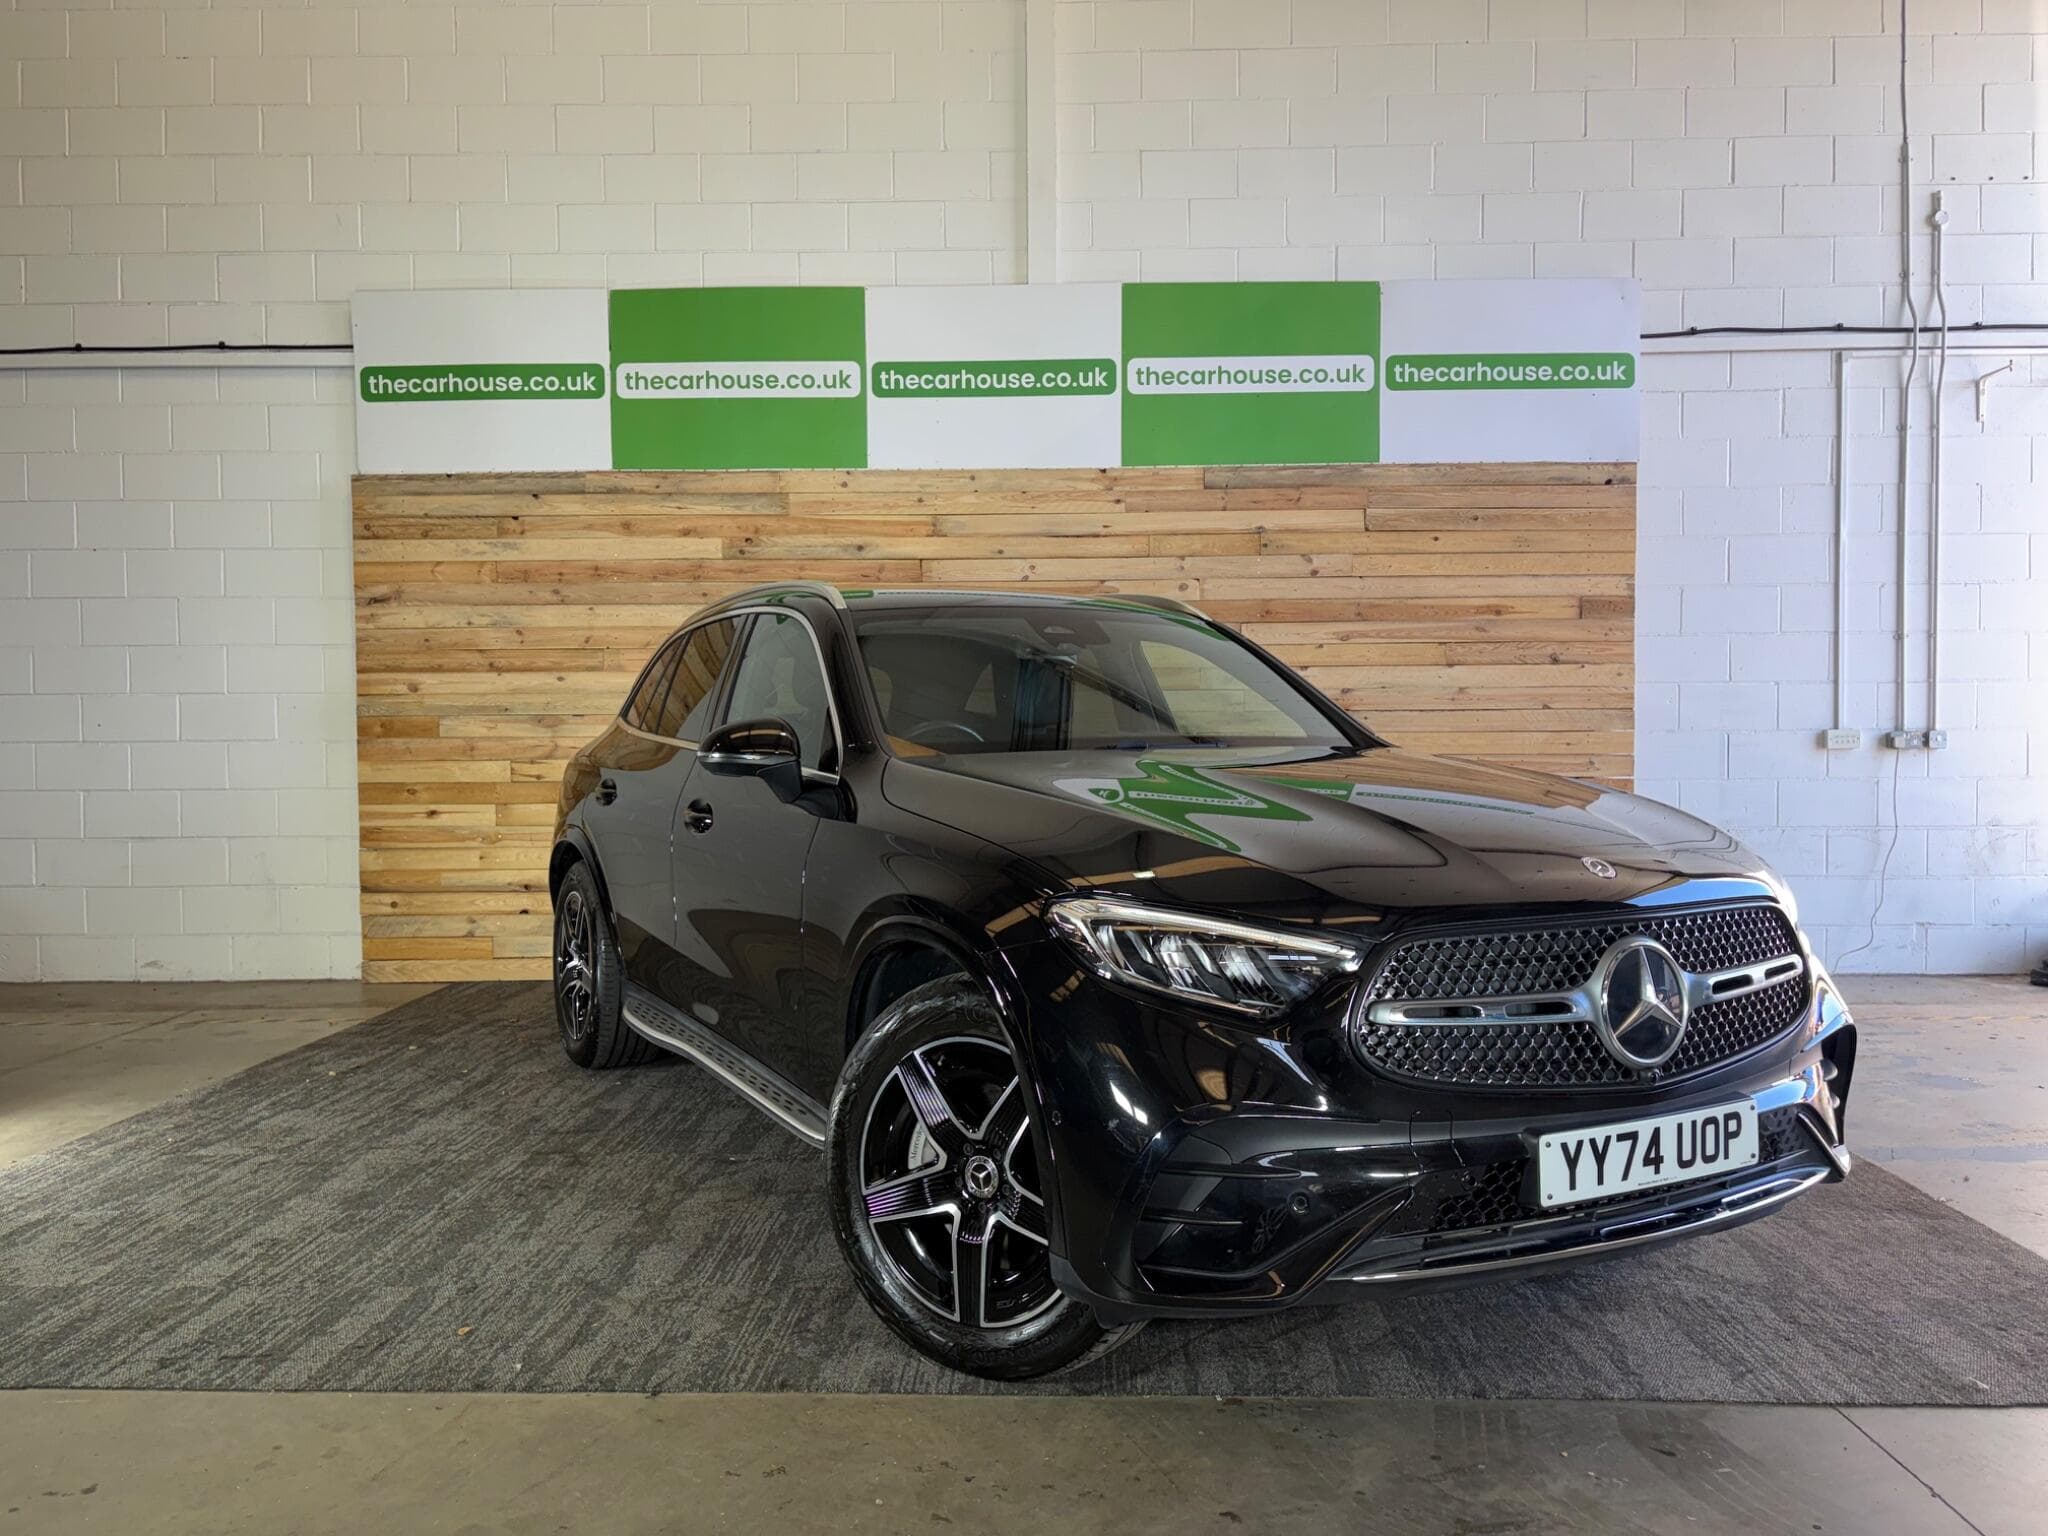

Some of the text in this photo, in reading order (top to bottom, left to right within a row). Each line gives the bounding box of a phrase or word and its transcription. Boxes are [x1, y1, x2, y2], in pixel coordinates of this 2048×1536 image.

[367, 371, 598, 395] thecarhouse.co.uk
[624, 369, 853, 391] thecarhouse.co.uk
[880, 367, 1109, 390] thecarhouse.co.uk
[1136, 364, 1366, 386] thecarhouse.co.uk
[1394, 361, 1627, 383] thecarhouse.co.uk
[1561, 1112, 1741, 1190] YY74 UOP
